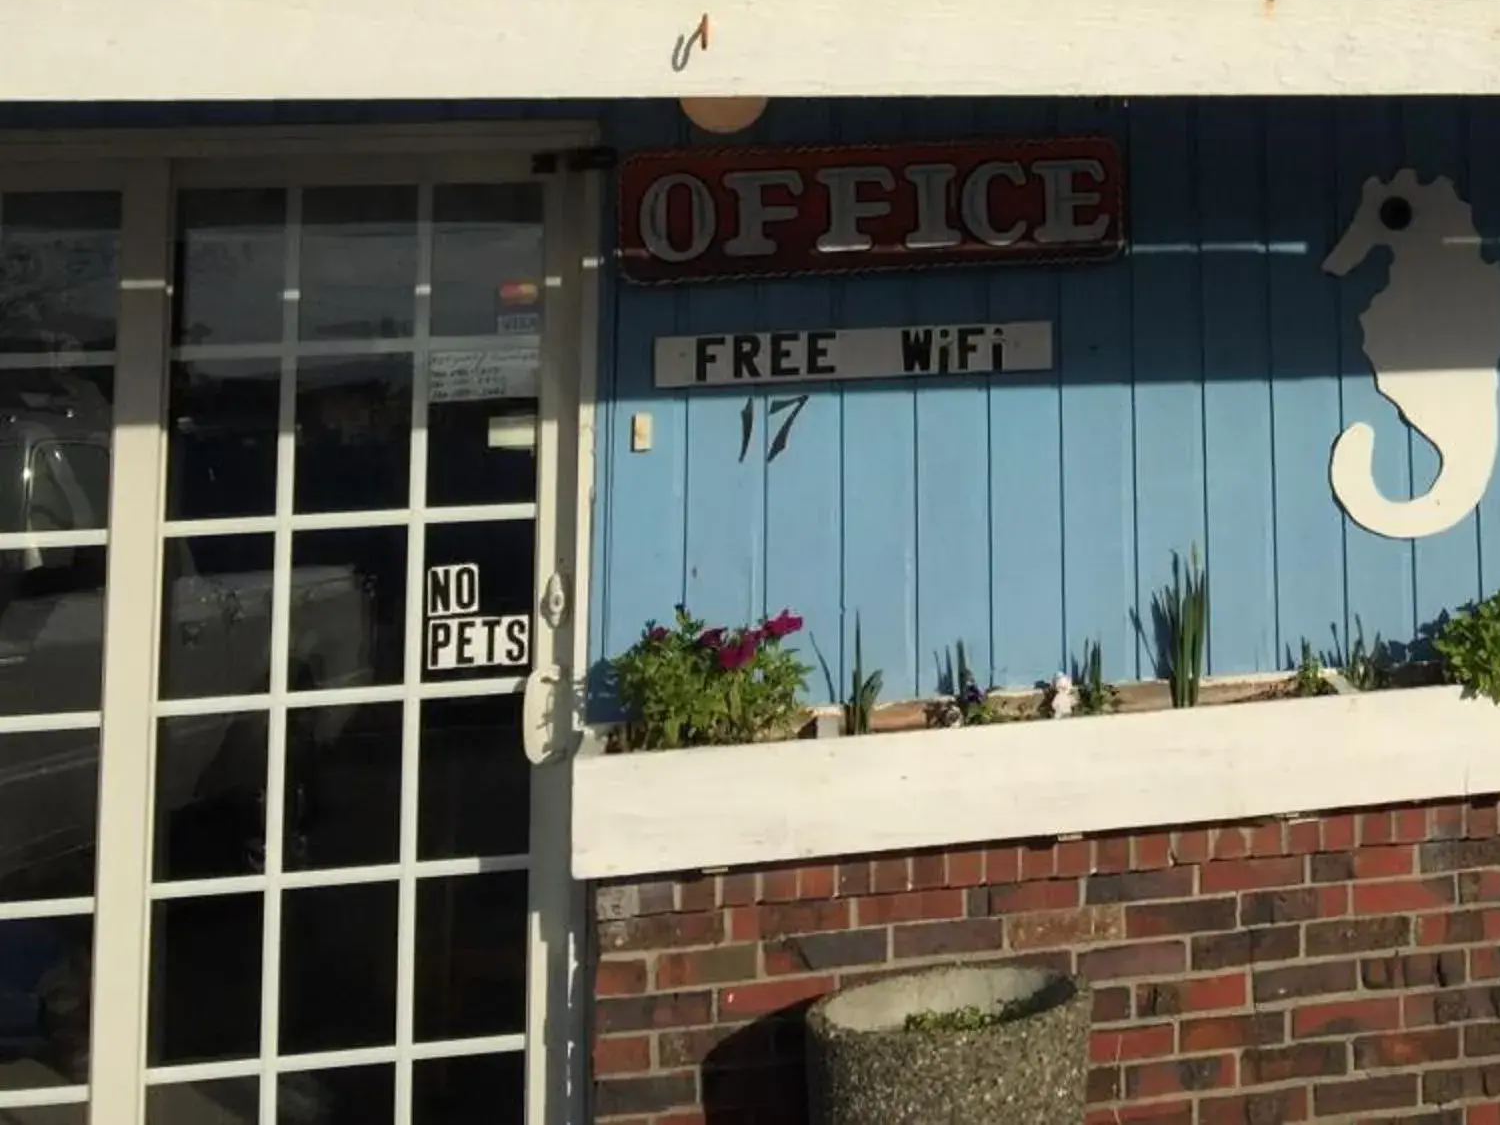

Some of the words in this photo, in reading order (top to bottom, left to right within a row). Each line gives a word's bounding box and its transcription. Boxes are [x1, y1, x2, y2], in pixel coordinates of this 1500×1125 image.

[639, 160, 1111, 262] OFFICE
[696, 331, 837, 382] FREE
[901, 327, 1005, 373] WiFi
[738, 395, 809, 463] 17
[430, 566, 476, 613] NO
[430, 618, 526, 667] PETS
